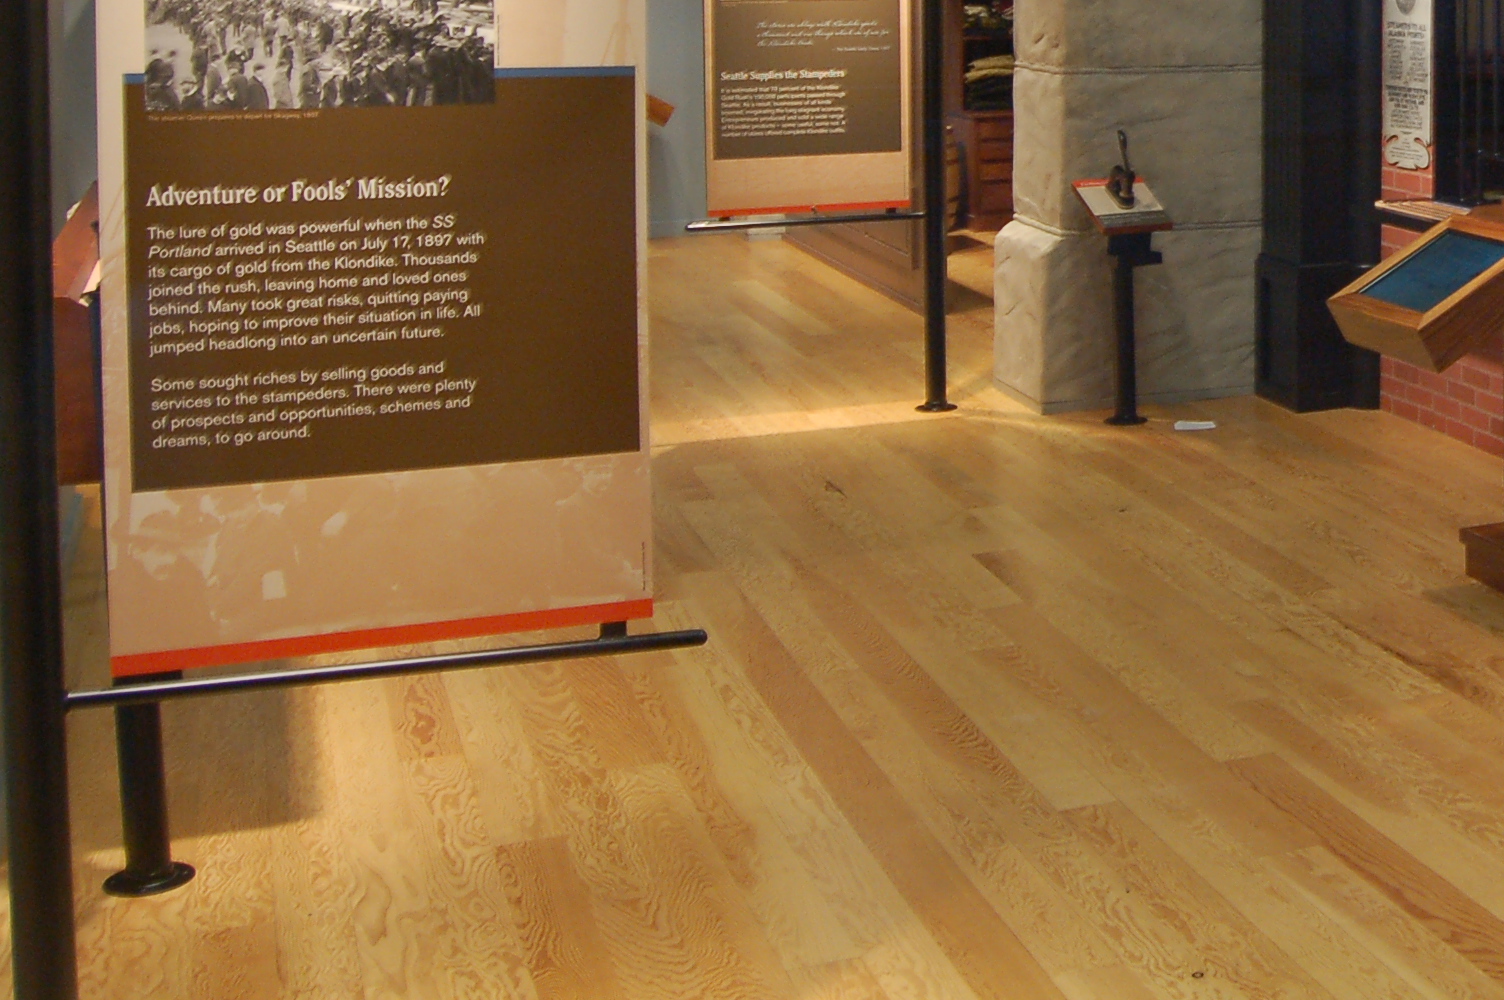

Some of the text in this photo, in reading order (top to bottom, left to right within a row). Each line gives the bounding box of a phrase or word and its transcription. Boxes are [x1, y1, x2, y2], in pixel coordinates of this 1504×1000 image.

[721, 68, 845, 82] Seattle Supplies the Stampeders
[146, 186, 258, 205] Adventure
[263, 186, 288, 202] or
[358, 176, 450, 198] Mission?
[147, 214, 454, 239] The lure of gold was powerful when the SS
[148, 232, 484, 257] Portland arrived in Seattle on July 17, 1897 with
[149, 252, 477, 279] its cargo of gold from the Klondike. Thousands
[149, 271, 466, 299] joined the rush, leaving home and loved ones
[149, 289, 467, 315] behind. Many took great risks, quitting paying
[150, 304, 480, 337] jobs, hoping to improve their situation in life. All
[150, 327, 443, 356] jumped headlong into an uncertain future.
[151, 361, 443, 391] Some sought riches by selling goods and
[152, 379, 476, 410] services to the stampeders. There were plenty
[152, 395, 470, 430] of prospects and opportunities, schemes and
[152, 425, 310, 447] dreams, to go around.
